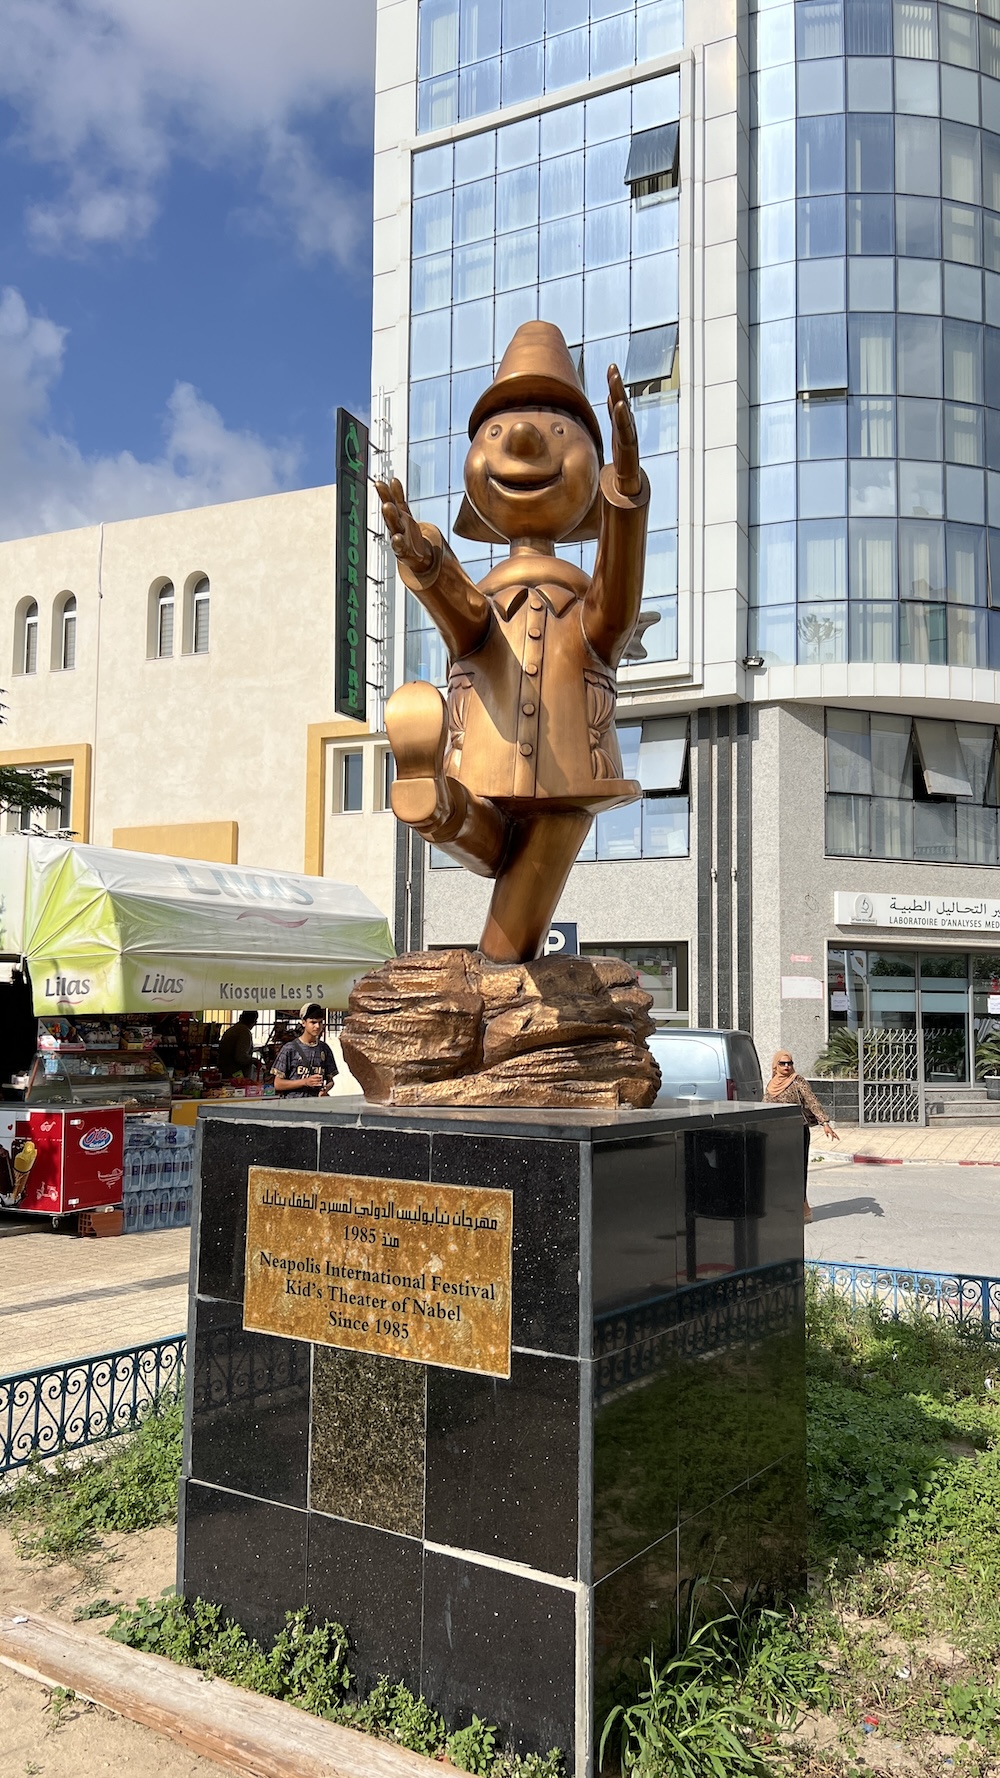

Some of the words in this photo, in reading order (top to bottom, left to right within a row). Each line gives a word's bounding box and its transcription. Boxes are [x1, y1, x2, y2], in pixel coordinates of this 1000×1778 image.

[347, 484, 360, 709] LABORATOIRE
[889, 897, 931, 914] الطبية
[936, 901, 987, 916] التحاليل
[889, 916, 938, 926] LABORATOIRE
[941, 918, 982, 928] D'ANALYSES
[543, 929, 566, 957] P
[45, 976, 91, 997] Lilas
[141, 973, 184, 994] Lilas
[220, 983, 276, 1003] Kiosque
[281, 984, 301, 999] Les
[306, 984, 313, 999] 5
[316, 984, 324, 999] S
[262, 1189, 287, 1210] بنابل
[288, 1192, 318, 1210] الطفل
[319, 1197, 353, 1214] لمسرح
[354, 1200, 394, 1220] الدولي
[396, 1204, 450, 1228] نيابوليس
[452, 1209, 498, 1231] مهرجان
[343, 1224, 376, 1244] 1985
[381, 1232, 399, 1248] منذ
[260, 1251, 321, 1275] Neapolis
[325, 1260, 426, 1290] International
[431, 1275, 495, 1301] Festival
[285, 1278, 323, 1299] Kid's
[327, 1285, 387, 1310] Theater
[391, 1297, 411, 1313] of
[412, 1298, 461, 1322] Nabel
[329, 1310, 369, 1332] Since
[375, 1318, 409, 1339] 1985
